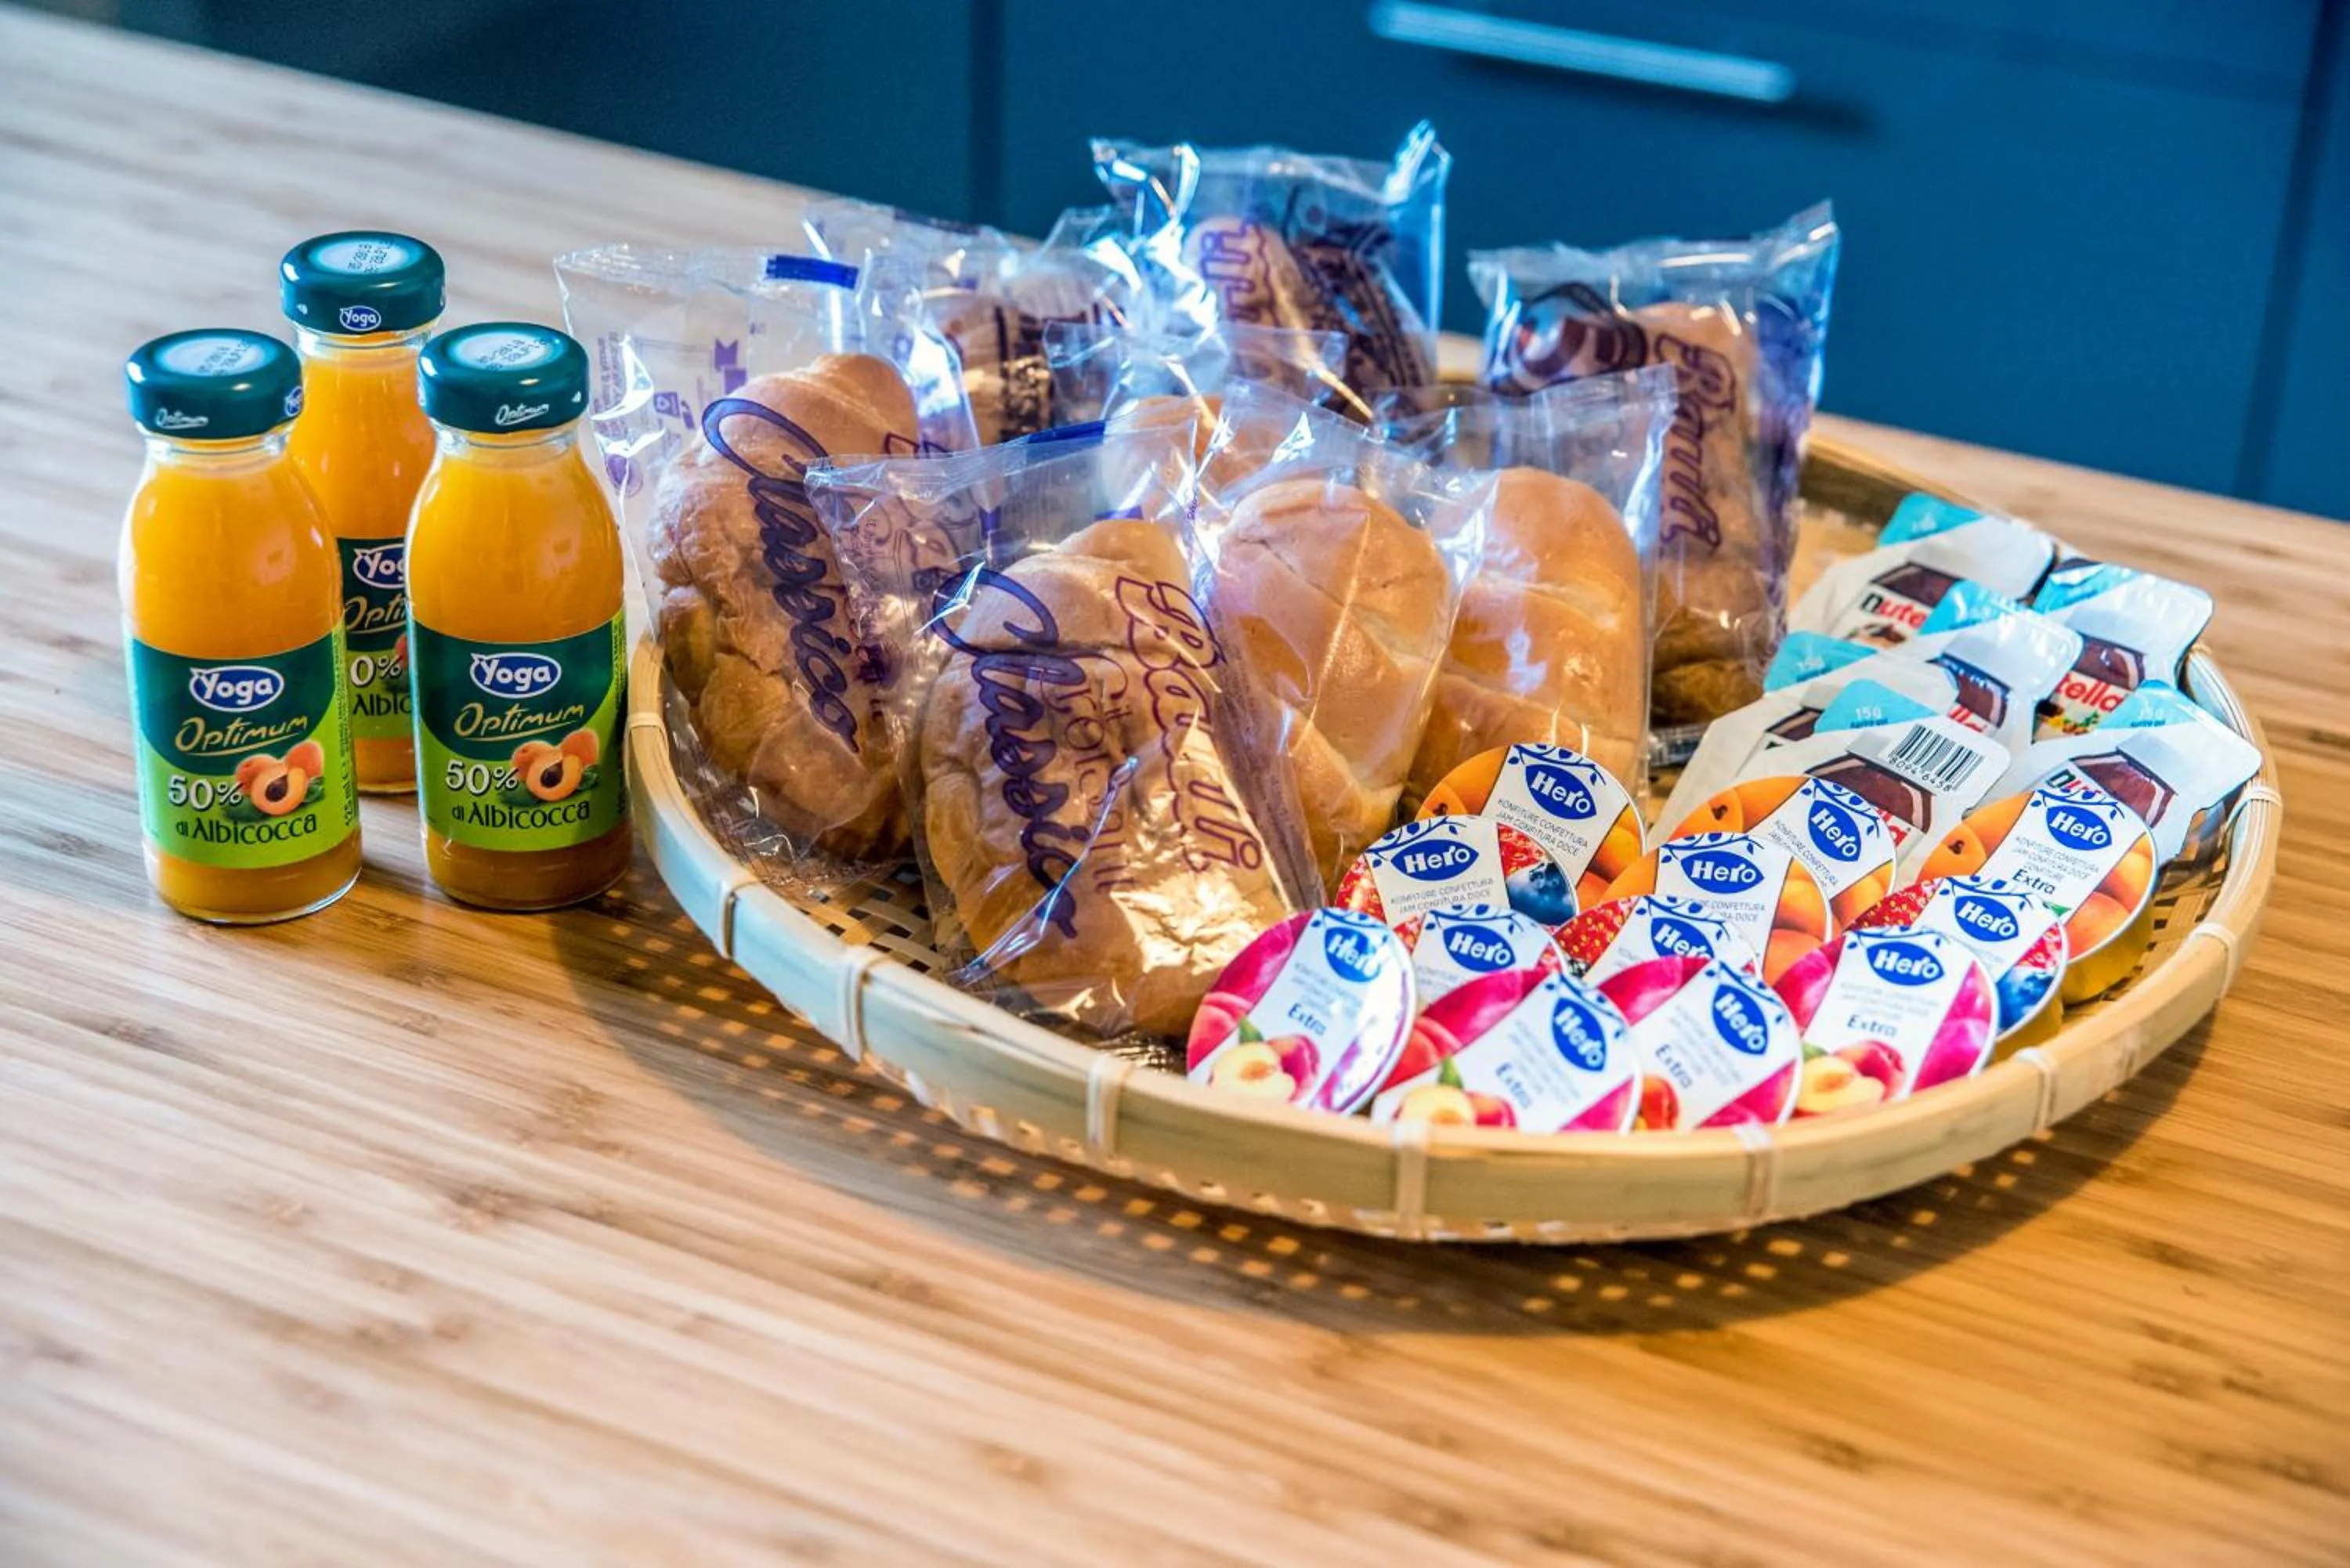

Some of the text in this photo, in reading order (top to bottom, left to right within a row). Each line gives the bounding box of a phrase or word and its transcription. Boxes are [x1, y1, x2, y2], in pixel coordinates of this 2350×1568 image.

[342, 308, 378, 327] Yoga
[703, 398, 860, 753] Classico
[200, 671, 274, 706] Yoga
[483, 656, 552, 692] Yoga
[174, 715, 309, 754] Optimum
[454, 702, 586, 740] Optimum
[931, 566, 1086, 938] Classico
[168, 774, 244, 811] 50%
[445, 759, 519, 794] 50%
[1530, 771, 1592, 814] Hero
[192, 813, 317, 845] Albicocca
[468, 800, 591, 829] Albicocca
[1810, 807, 1857, 858] Hero
[2048, 811, 2109, 846] Hero
[1539, 818, 1589, 849] CONFETTURA
[1556, 840, 1581, 857] DOCE
[1403, 845, 1471, 874] Hero
[1690, 859, 1757, 883] Hero
[2012, 868, 2056, 895] Extra
[1956, 900, 2018, 938] Hero
[1327, 933, 1382, 979] Hero
[1448, 930, 1512, 966] Hero
[1872, 948, 1940, 980] Hero
[1287, 1001, 1328, 1037] Extra
[1553, 1006, 1604, 1068] Hero
[1714, 992, 1766, 1051] Hero
[1846, 1013, 1898, 1039] Extra
[1654, 1042, 1694, 1089] Extra
[1495, 1062, 1533, 1111] Extra
